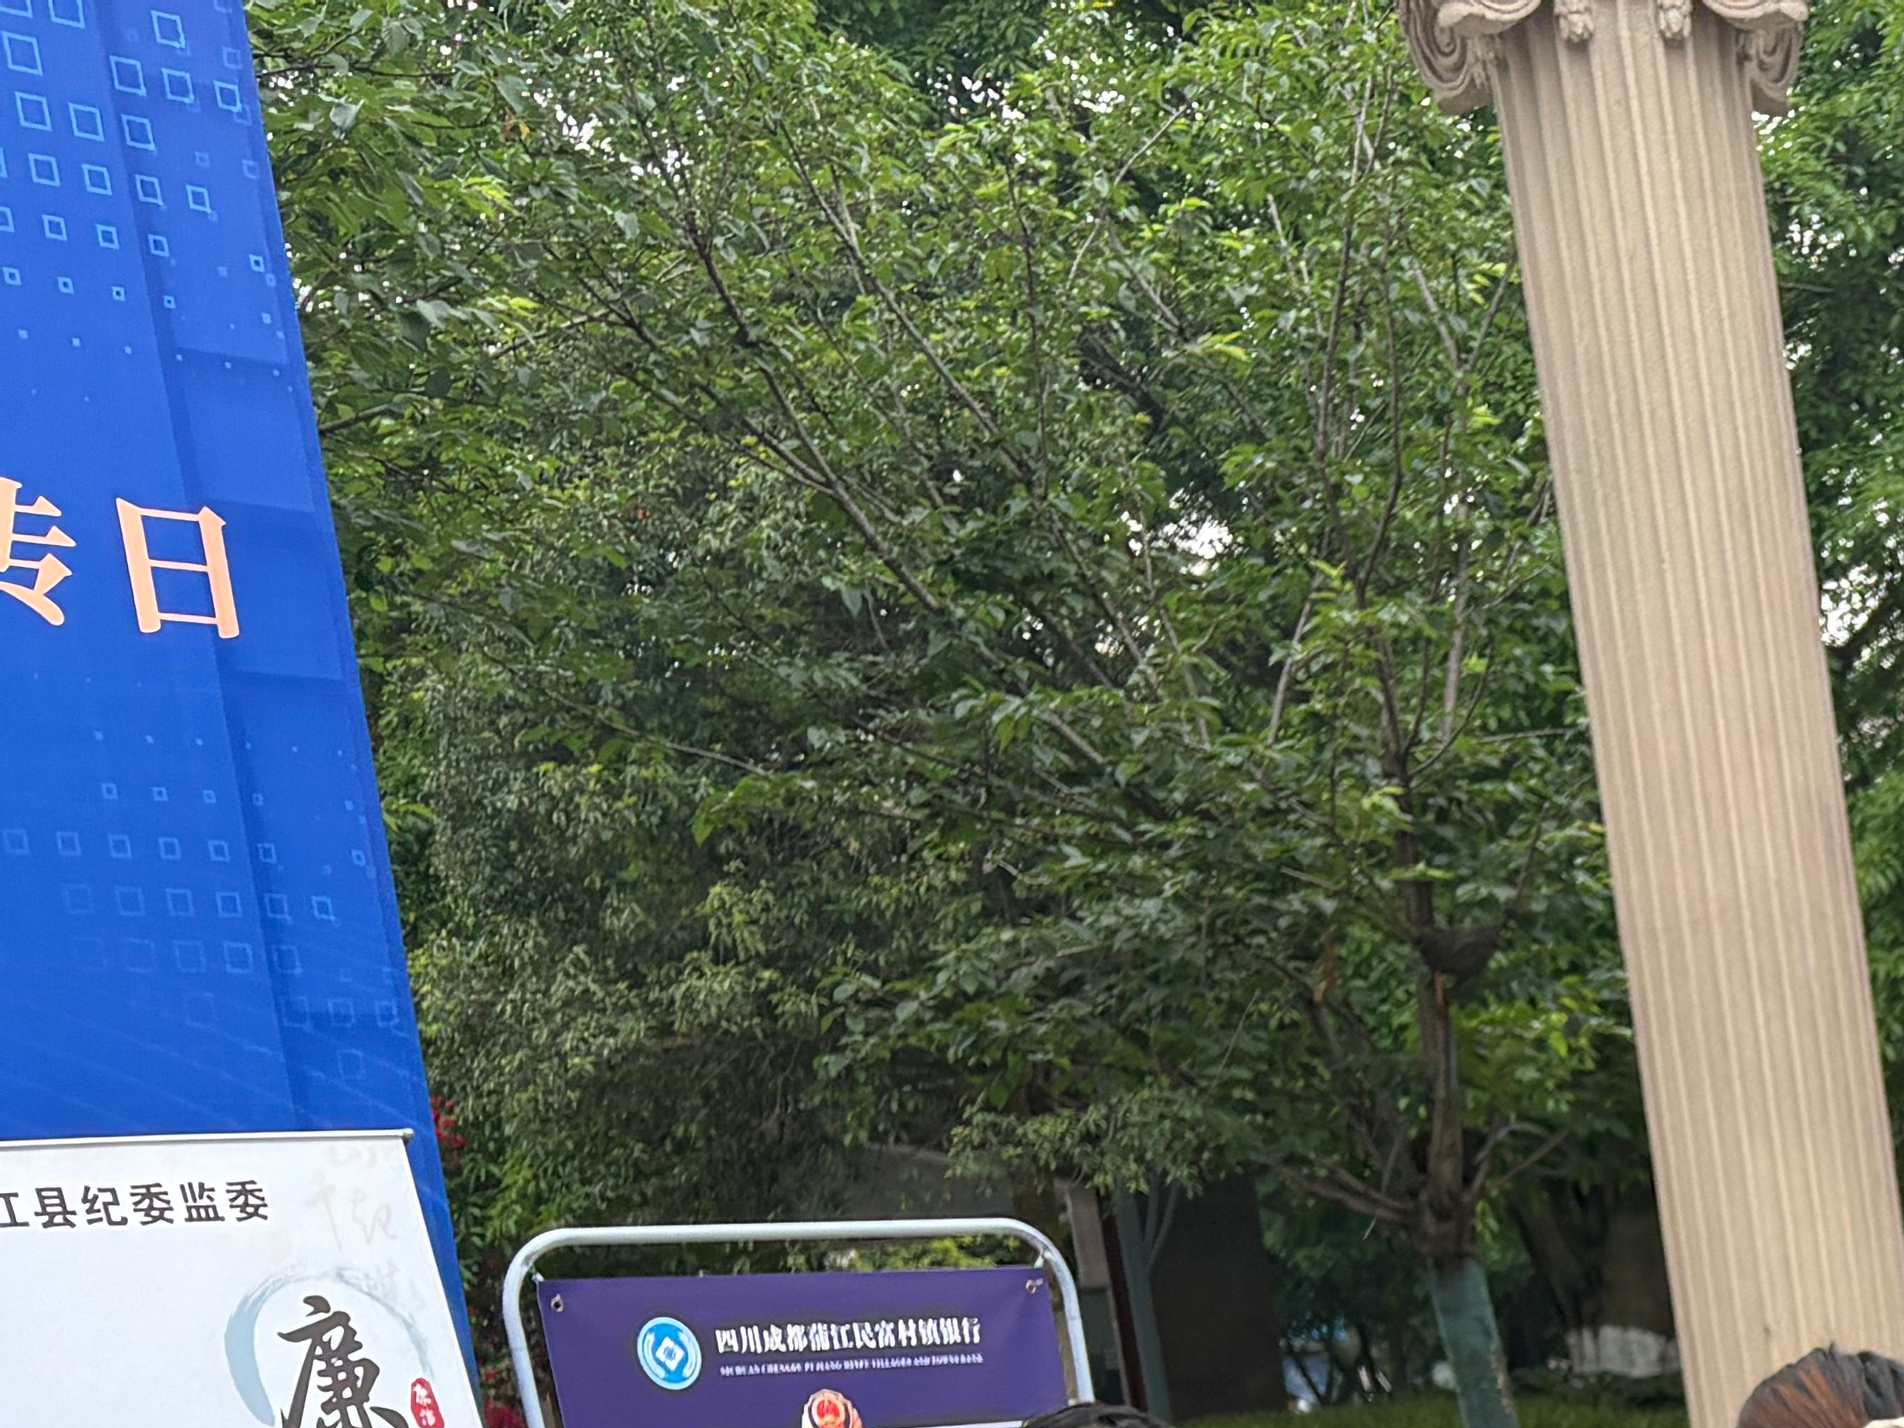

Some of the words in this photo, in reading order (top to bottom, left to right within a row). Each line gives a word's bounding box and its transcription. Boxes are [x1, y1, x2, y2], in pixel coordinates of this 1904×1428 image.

[714, 1316, 980, 1354] 四川成都蒲江民富村镇银行
